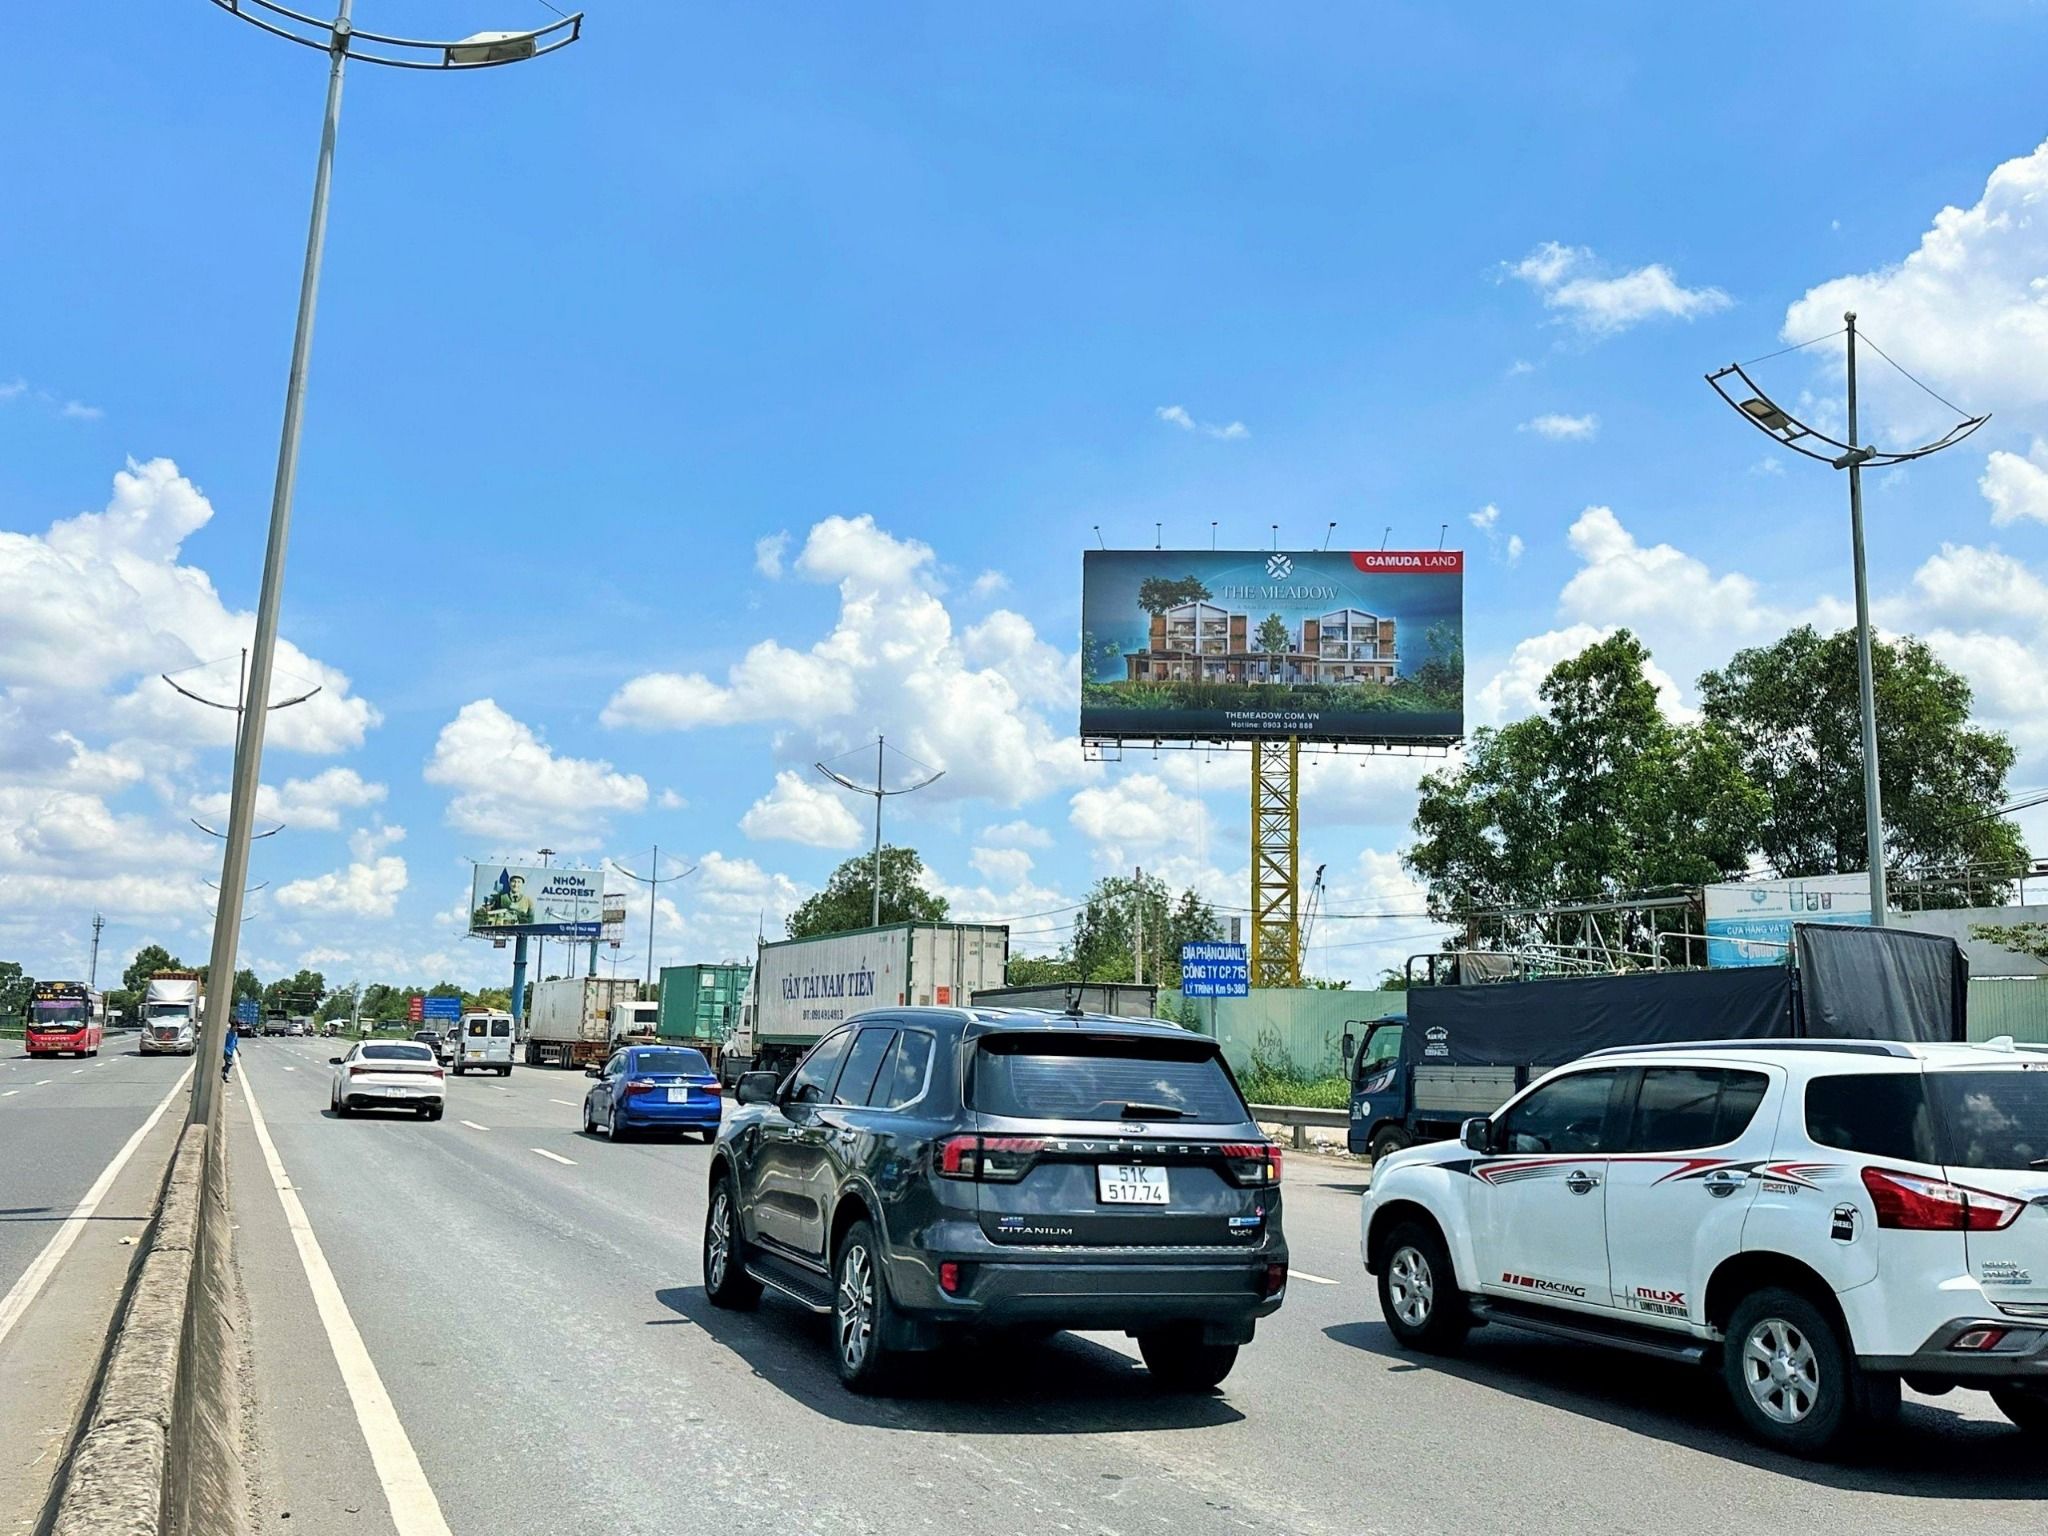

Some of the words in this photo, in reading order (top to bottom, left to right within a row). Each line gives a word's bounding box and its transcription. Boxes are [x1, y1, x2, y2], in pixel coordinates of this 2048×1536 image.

[1366, 556, 1421, 566] GAMUDA
[1425, 556, 1457, 566] LAND
[1221, 585, 1255, 599] THE
[1261, 585, 1339, 599] MEADOW
[1225, 711, 1320, 720] THEMEADOW.COM.VN
[553, 876, 586, 886] NHÔM
[541, 886, 596, 897] ALCOREST
[1183, 962, 1206, 979] CÔNG
[1207, 965, 1218, 979] TY
[781, 972, 801, 1005] VẬN
[802, 967, 820, 999] TẢI
[820, 973, 845, 998] NAM
[847, 955, 875, 997] TIẾN
[1215, 983, 1226, 994] Km
[1057, 1142, 1210, 1154] EVEREST
[1119, 1167, 1148, 1183] 51K
[1109, 1185, 1162, 1201] 517.74
[997, 1226, 1073, 1235] TITANIUM
[1535, 1279, 1586, 1298] RACING
[1639, 1300, 1664, 1315] LIMITED
